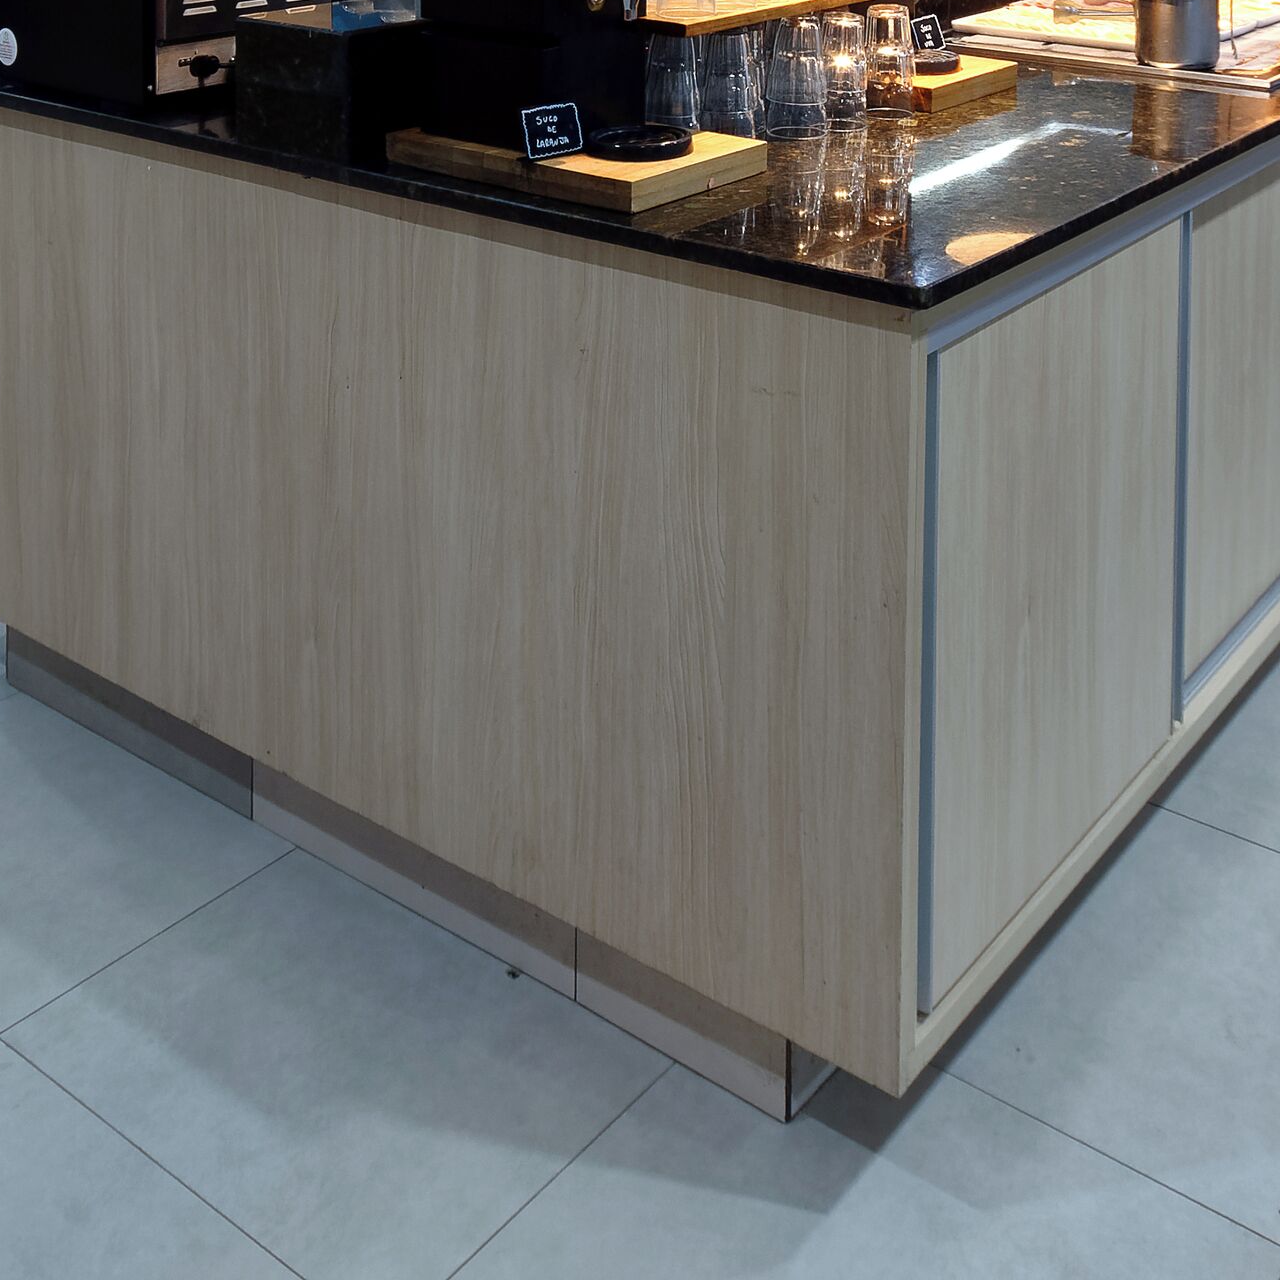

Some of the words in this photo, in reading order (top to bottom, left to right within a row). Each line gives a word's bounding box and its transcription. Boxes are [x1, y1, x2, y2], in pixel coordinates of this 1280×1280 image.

[535, 115, 558, 125] SUCO
[547, 125, 557, 133] DE
[536, 136, 569, 148] LARANJA
